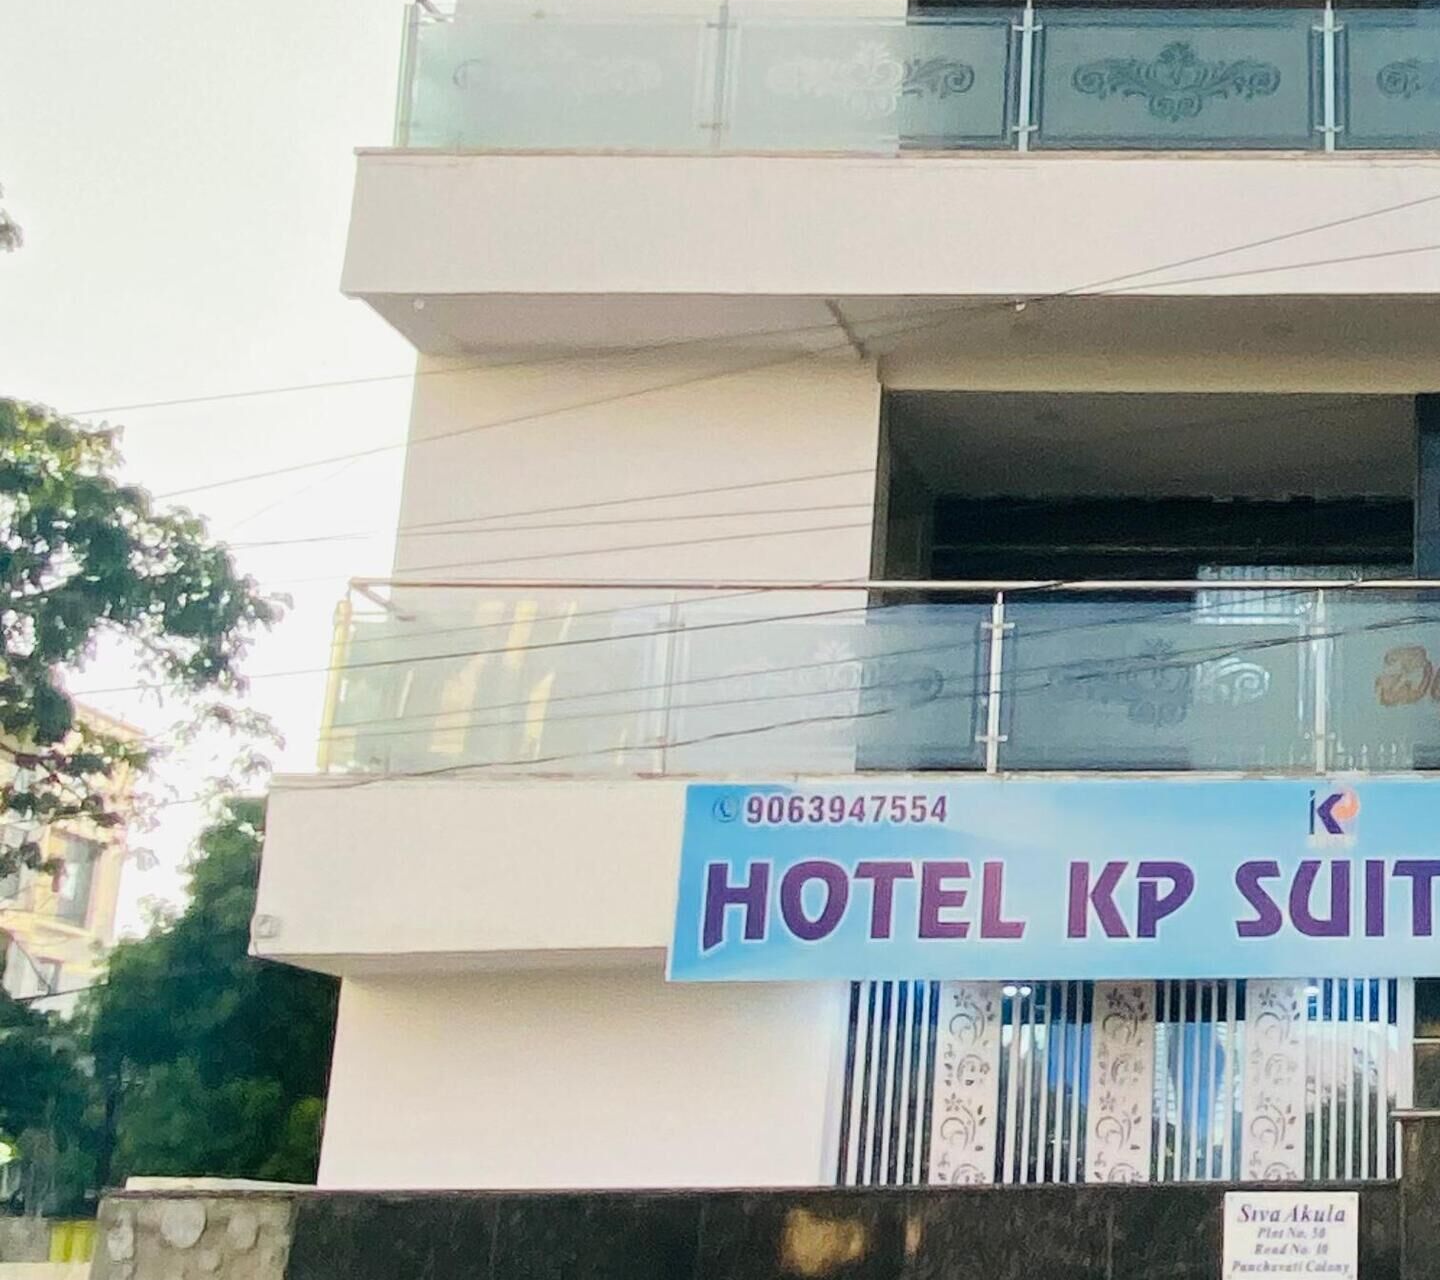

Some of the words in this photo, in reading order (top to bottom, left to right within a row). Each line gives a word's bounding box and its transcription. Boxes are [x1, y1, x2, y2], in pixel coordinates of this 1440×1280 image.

[745, 795, 948, 824] 9063947554
[702, 860, 1026, 951] HOTEL
[1066, 860, 1195, 938] KP
[1283, 1203, 1346, 1223] Akula
